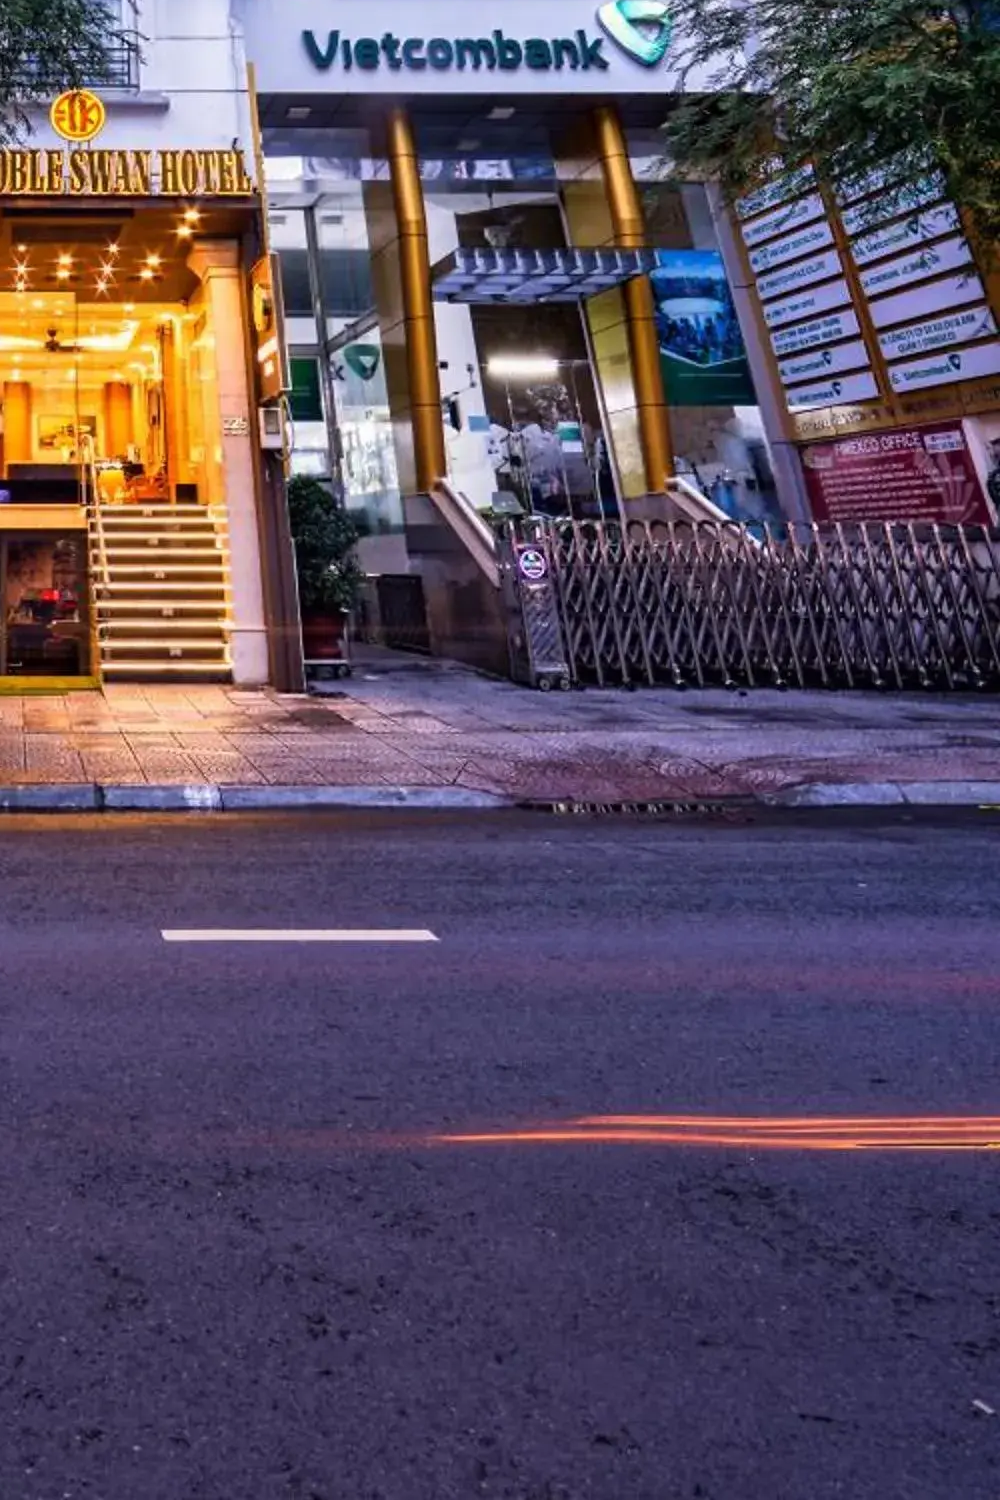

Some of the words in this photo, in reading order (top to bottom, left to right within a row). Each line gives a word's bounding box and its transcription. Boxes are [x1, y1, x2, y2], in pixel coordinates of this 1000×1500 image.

[302, 28, 609, 71] Vietcombank
[68, 150, 152, 194] SWAN
[156, 150, 252, 194] HOTEL
